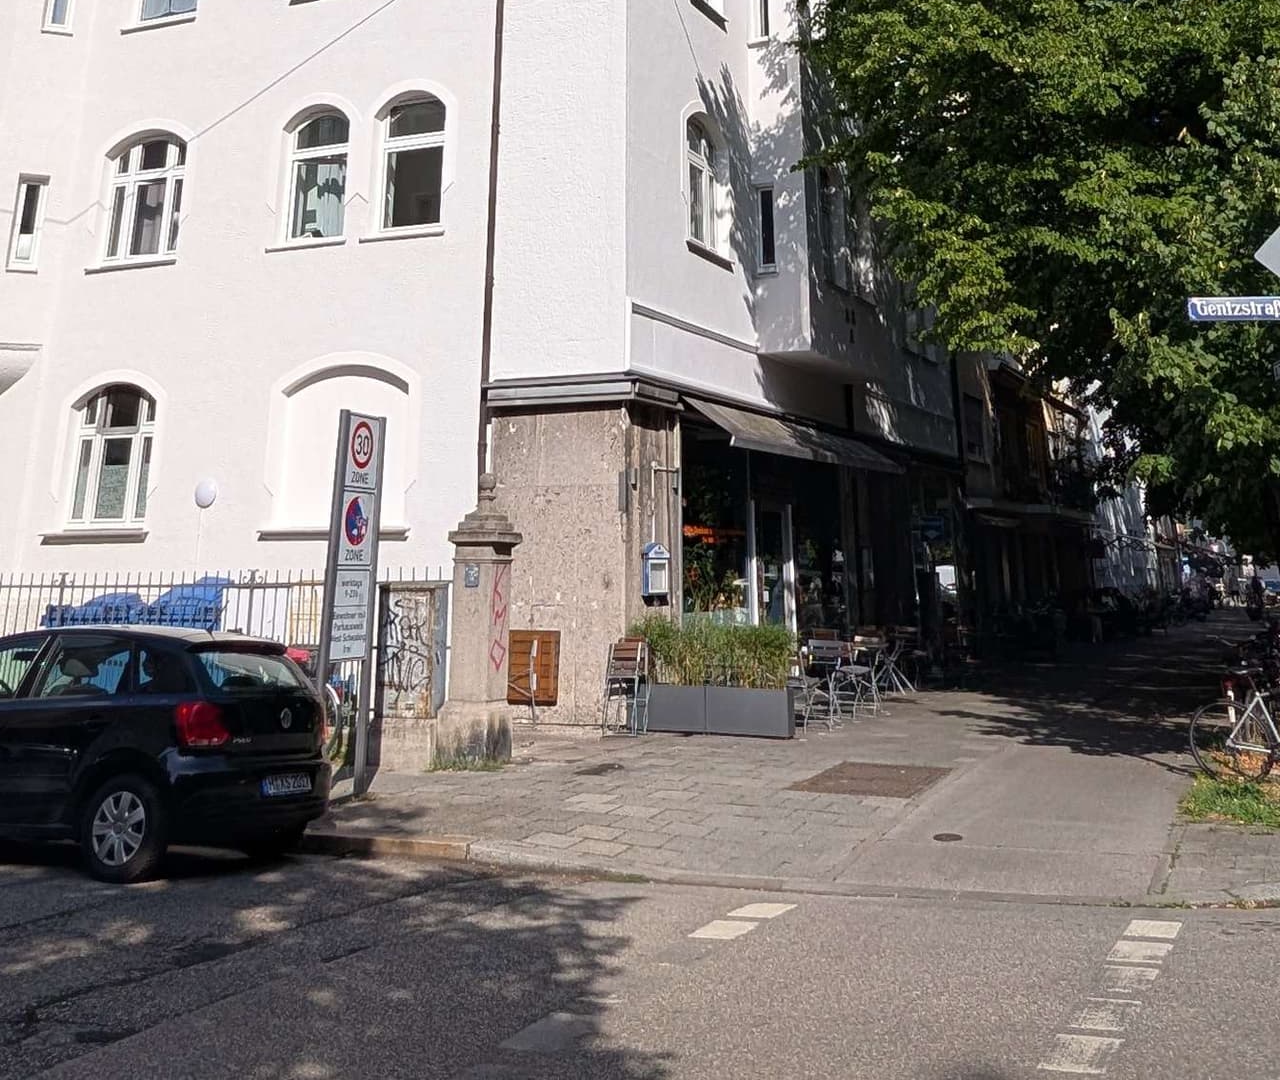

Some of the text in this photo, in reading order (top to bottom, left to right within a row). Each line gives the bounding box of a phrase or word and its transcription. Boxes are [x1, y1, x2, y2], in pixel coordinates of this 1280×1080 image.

[355, 434, 370, 457] 30
[351, 471, 369, 485] ZONE
[345, 549, 364, 562] ZONE
